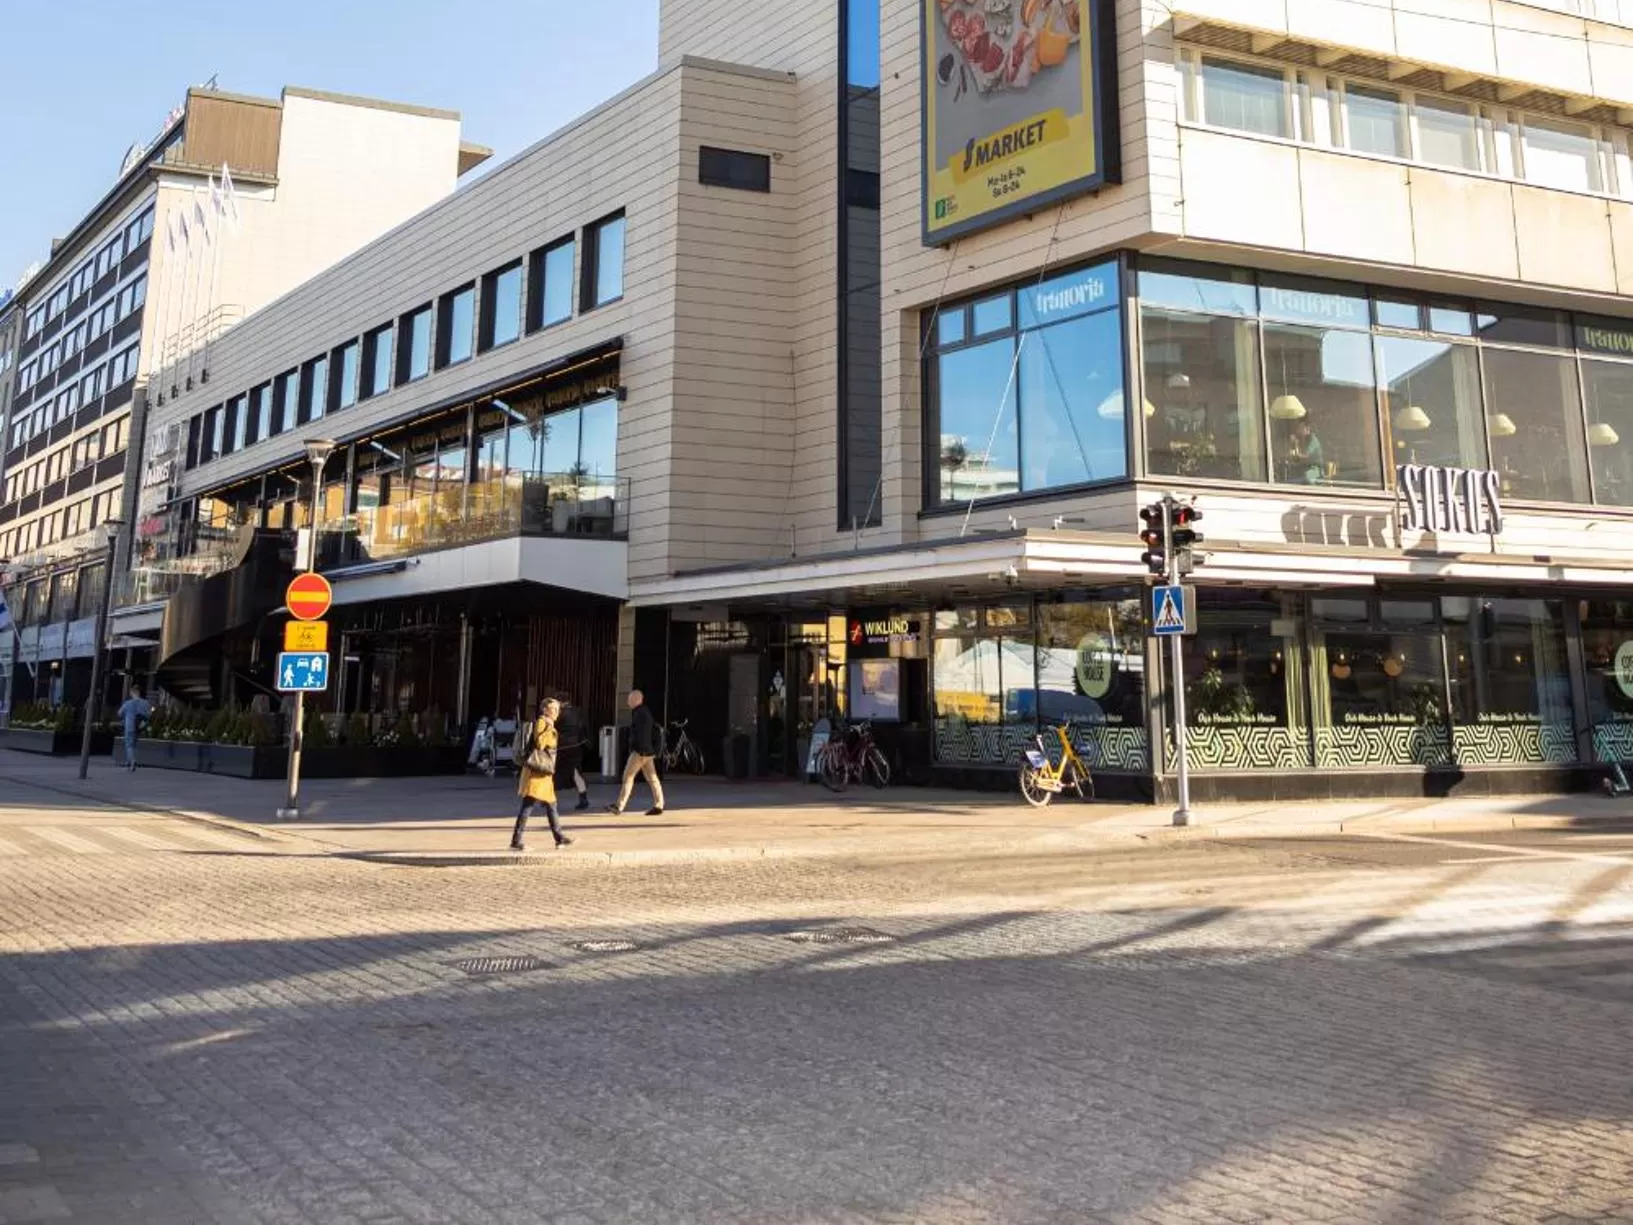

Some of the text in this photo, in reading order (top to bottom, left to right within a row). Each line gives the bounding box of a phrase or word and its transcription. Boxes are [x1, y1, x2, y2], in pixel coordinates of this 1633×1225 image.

[976, 120, 1046, 166] MARKET
[1400, 464, 1503, 535] SOKOS
[865, 620, 908, 635] WIKLUND
